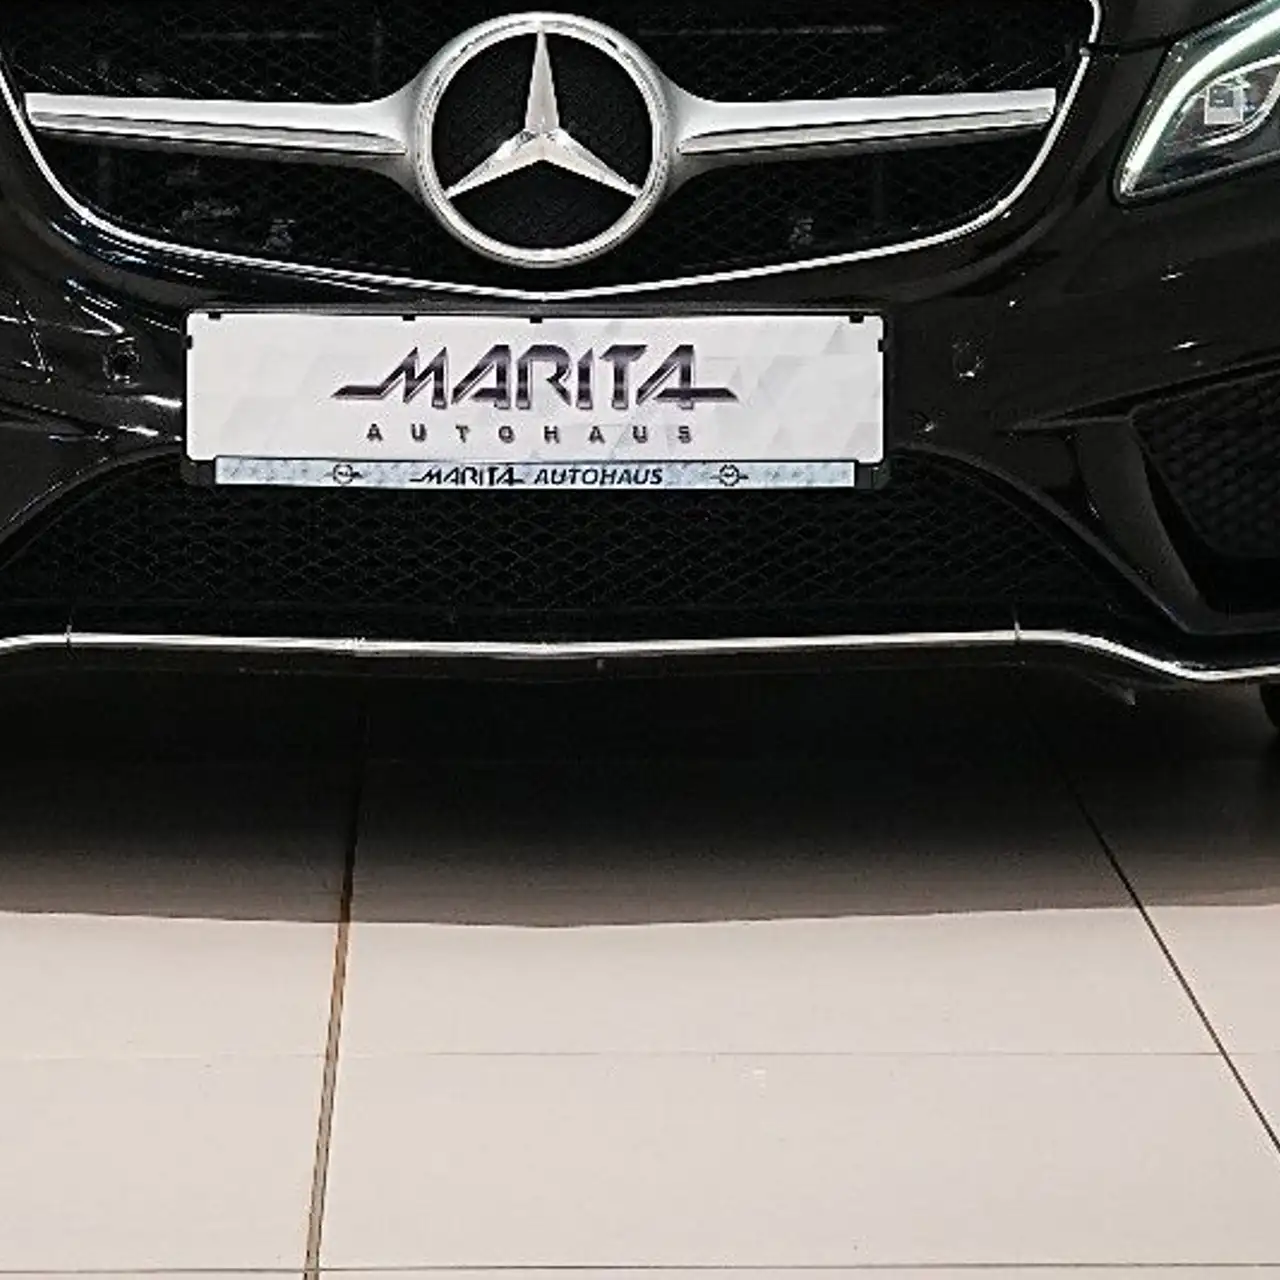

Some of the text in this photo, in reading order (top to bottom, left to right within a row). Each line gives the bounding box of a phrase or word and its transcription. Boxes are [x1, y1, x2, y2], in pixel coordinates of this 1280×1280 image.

[330, 344, 738, 410] MARITA
[366, 423, 693, 444] AUTOHAUS
[410, 466, 663, 486] MARITA AUTOHAUS
